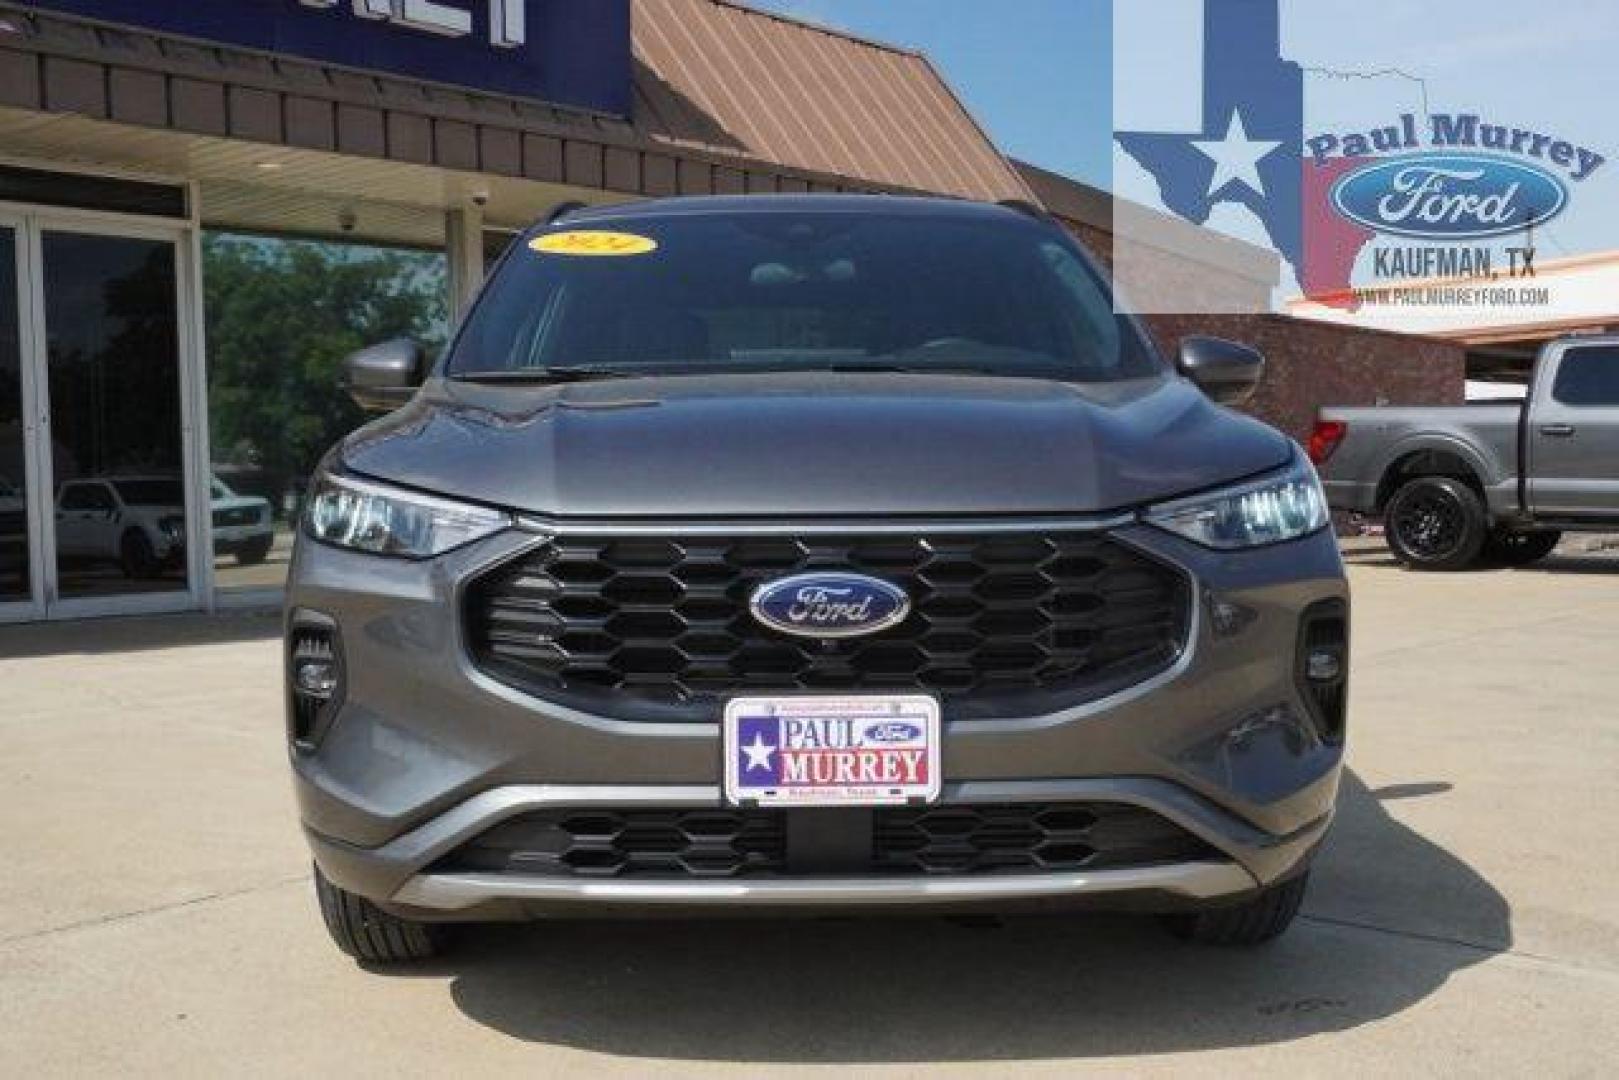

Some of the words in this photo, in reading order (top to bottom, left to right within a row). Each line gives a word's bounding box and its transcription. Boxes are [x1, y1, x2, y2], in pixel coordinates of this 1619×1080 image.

[788, 586, 874, 622] Ford
[785, 719, 862, 748] PAUL
[782, 752, 923, 783] MURREY
